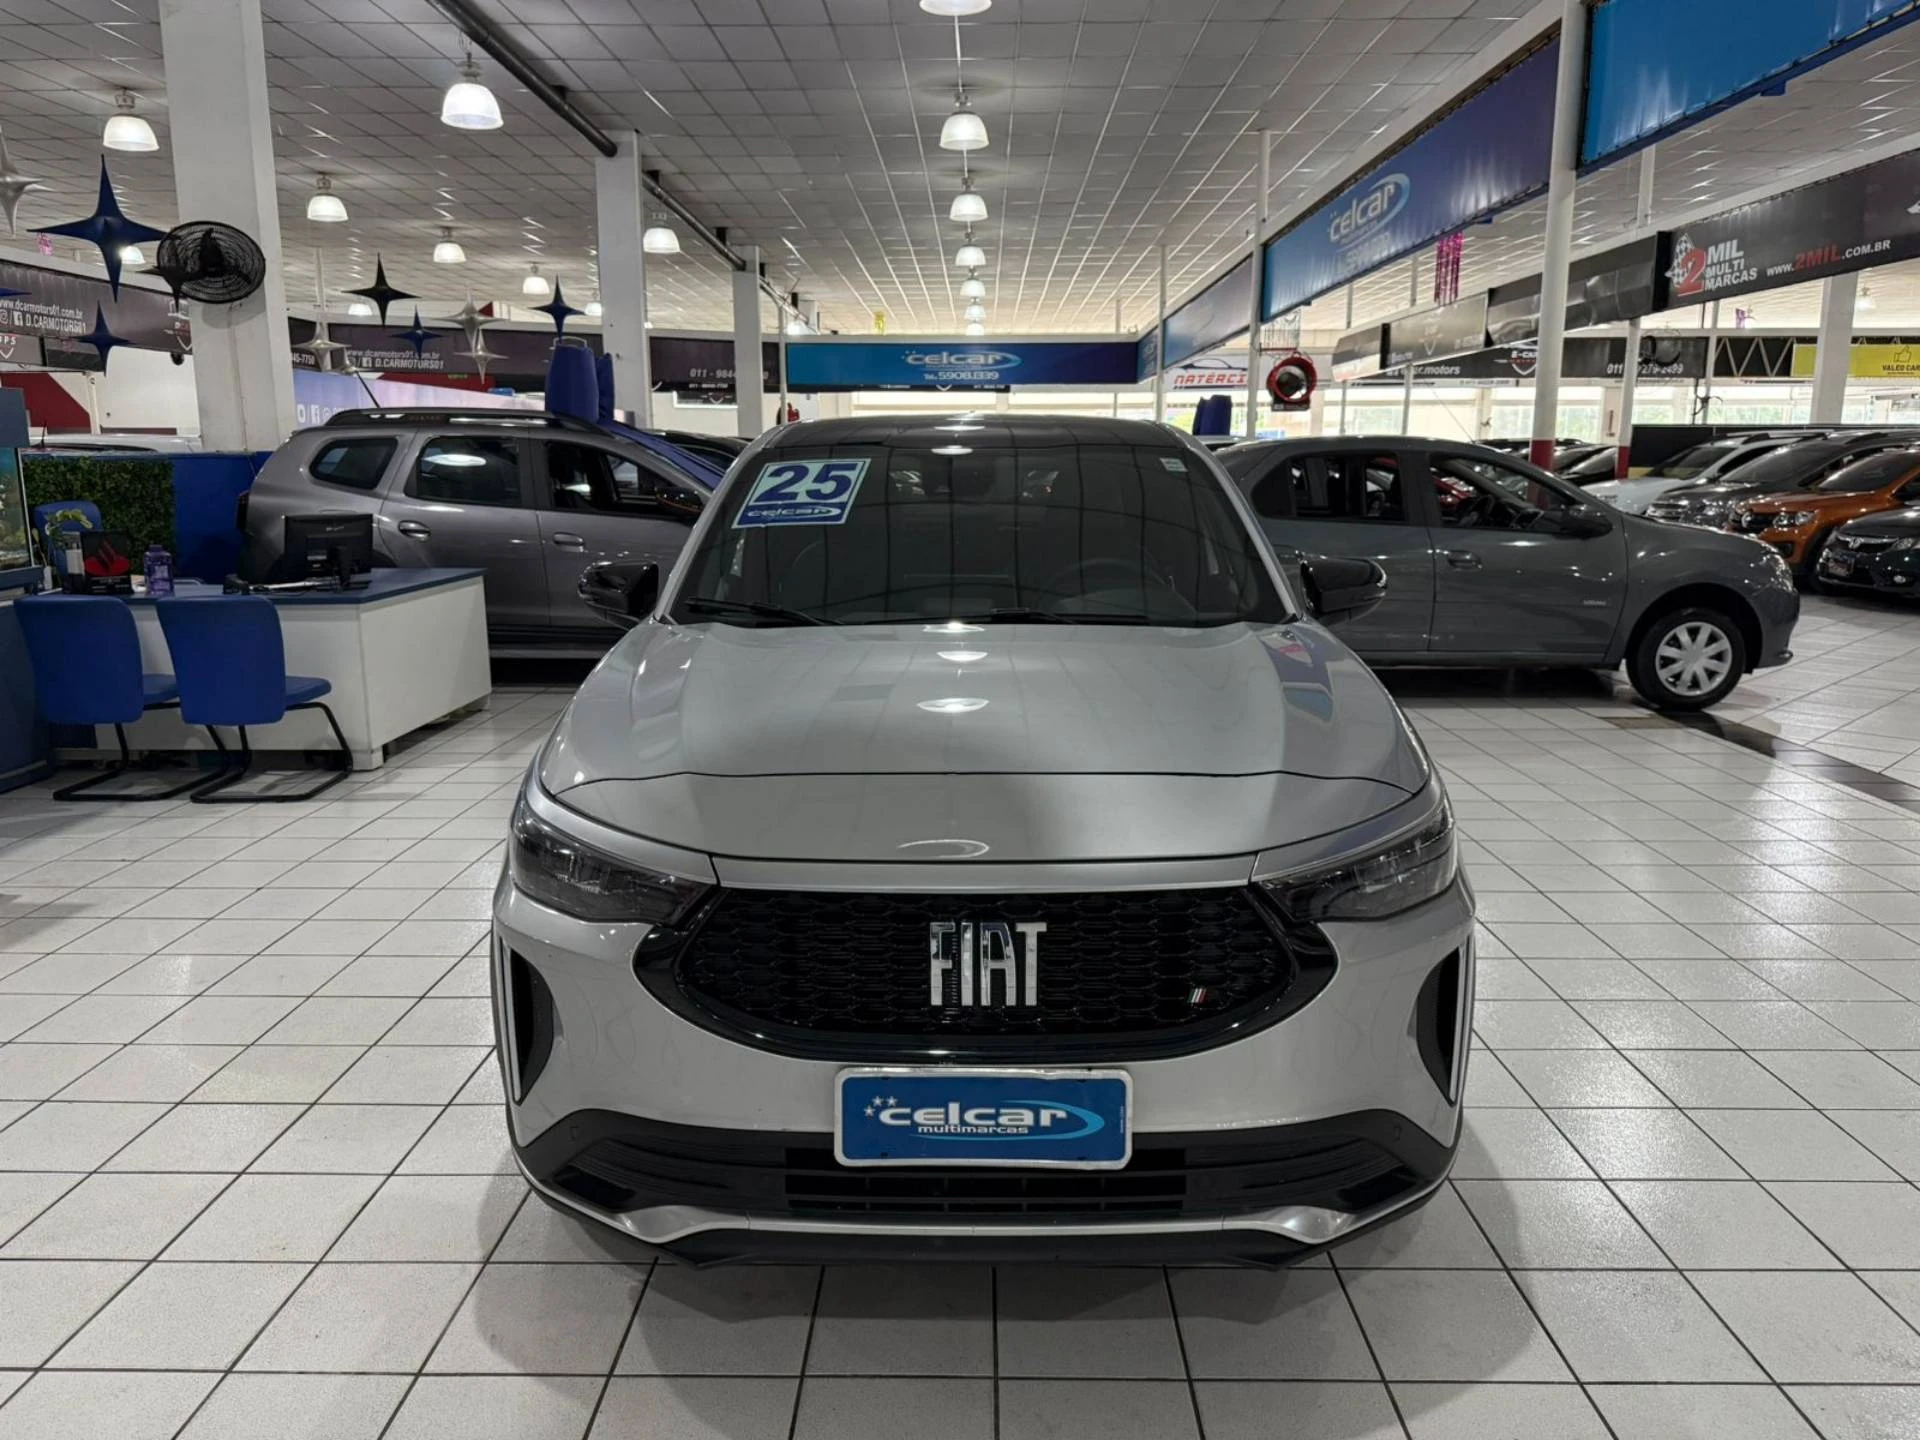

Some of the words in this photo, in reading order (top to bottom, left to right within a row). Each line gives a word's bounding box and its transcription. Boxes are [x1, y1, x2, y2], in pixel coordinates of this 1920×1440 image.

[1330, 183, 1395, 242] celcar
[1676, 247, 1706, 296] 2
[1707, 239, 1744, 263] MIL
[1704, 267, 1758, 291] MARCAS
[1705, 260, 1745, 276] MULTI
[906, 352, 1003, 365] celcar
[1174, 371, 1247, 385] NATÉRCI
[753, 463, 853, 502] 25
[930, 922, 1047, 1006] FIAT
[879, 1102, 1067, 1128] celcar
[917, 1123, 1029, 1135] multimarcas
